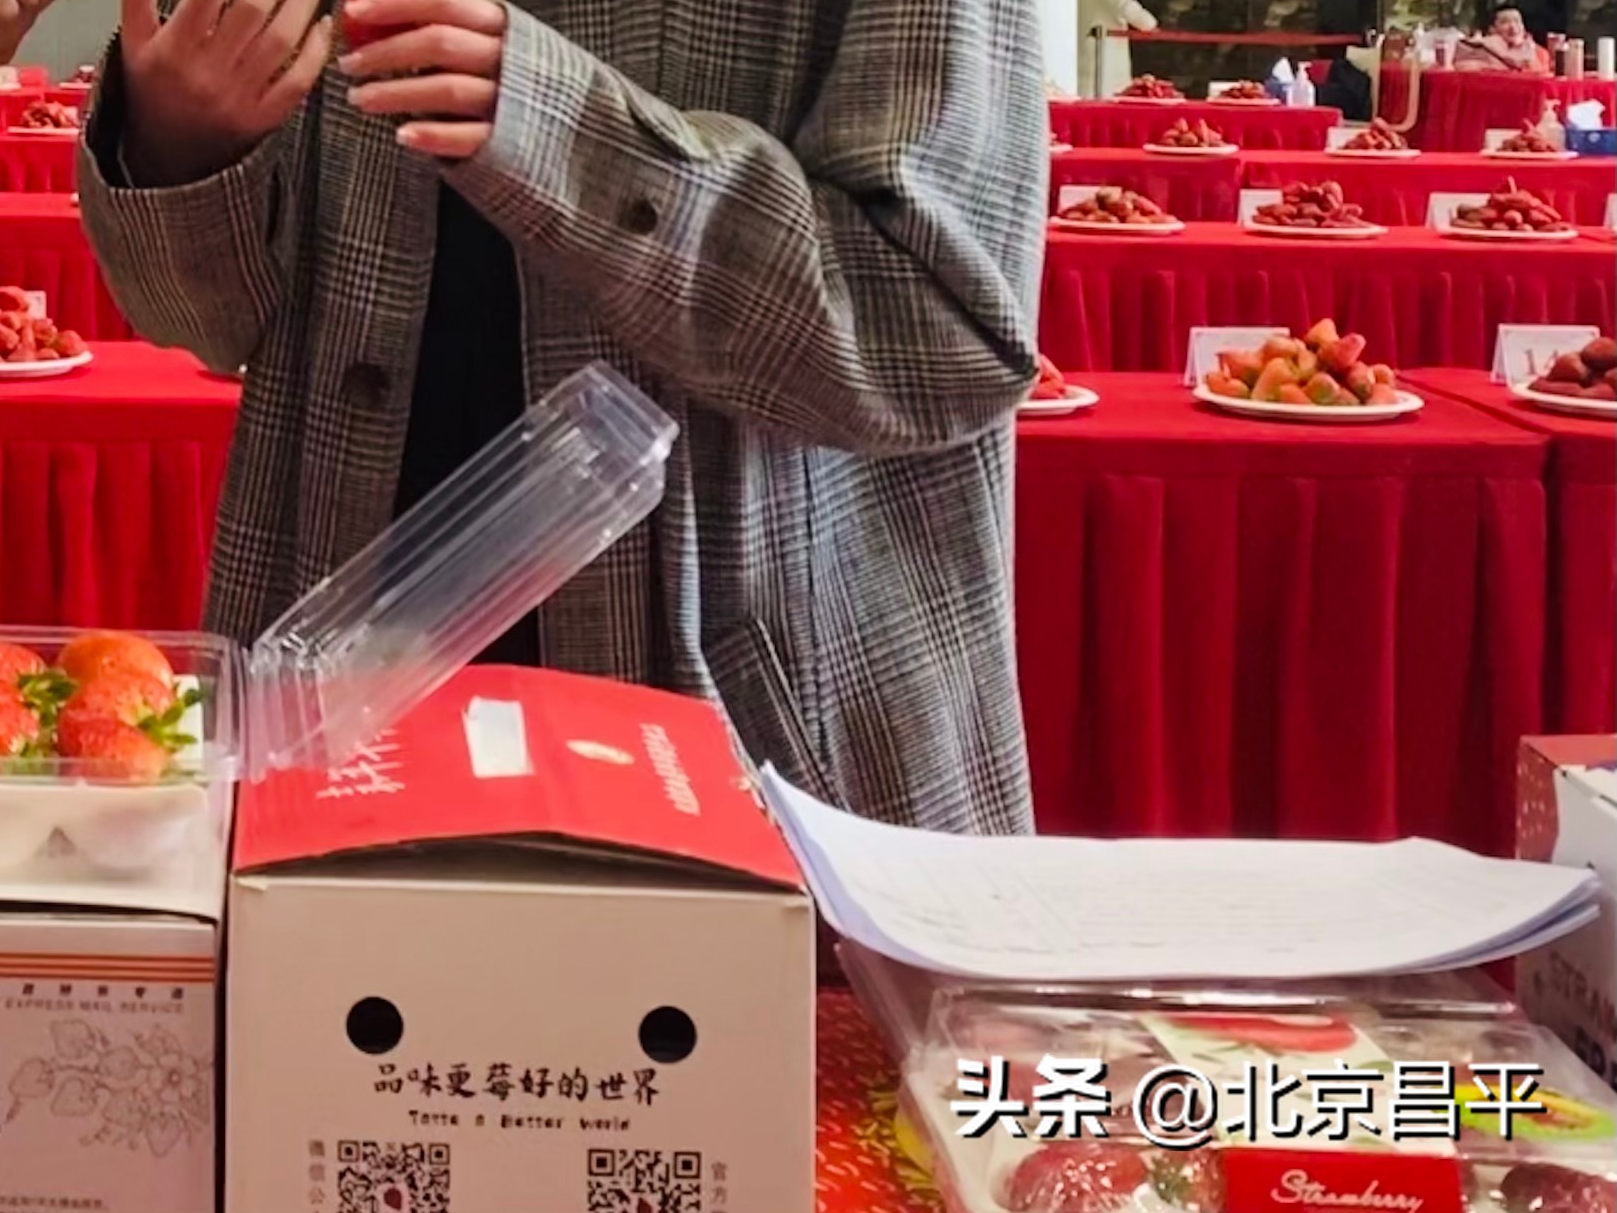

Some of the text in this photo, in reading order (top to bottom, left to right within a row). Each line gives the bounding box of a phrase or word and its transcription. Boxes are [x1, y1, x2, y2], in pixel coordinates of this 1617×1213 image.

[373, 1062, 660, 1107] 品味更莓好的世界
